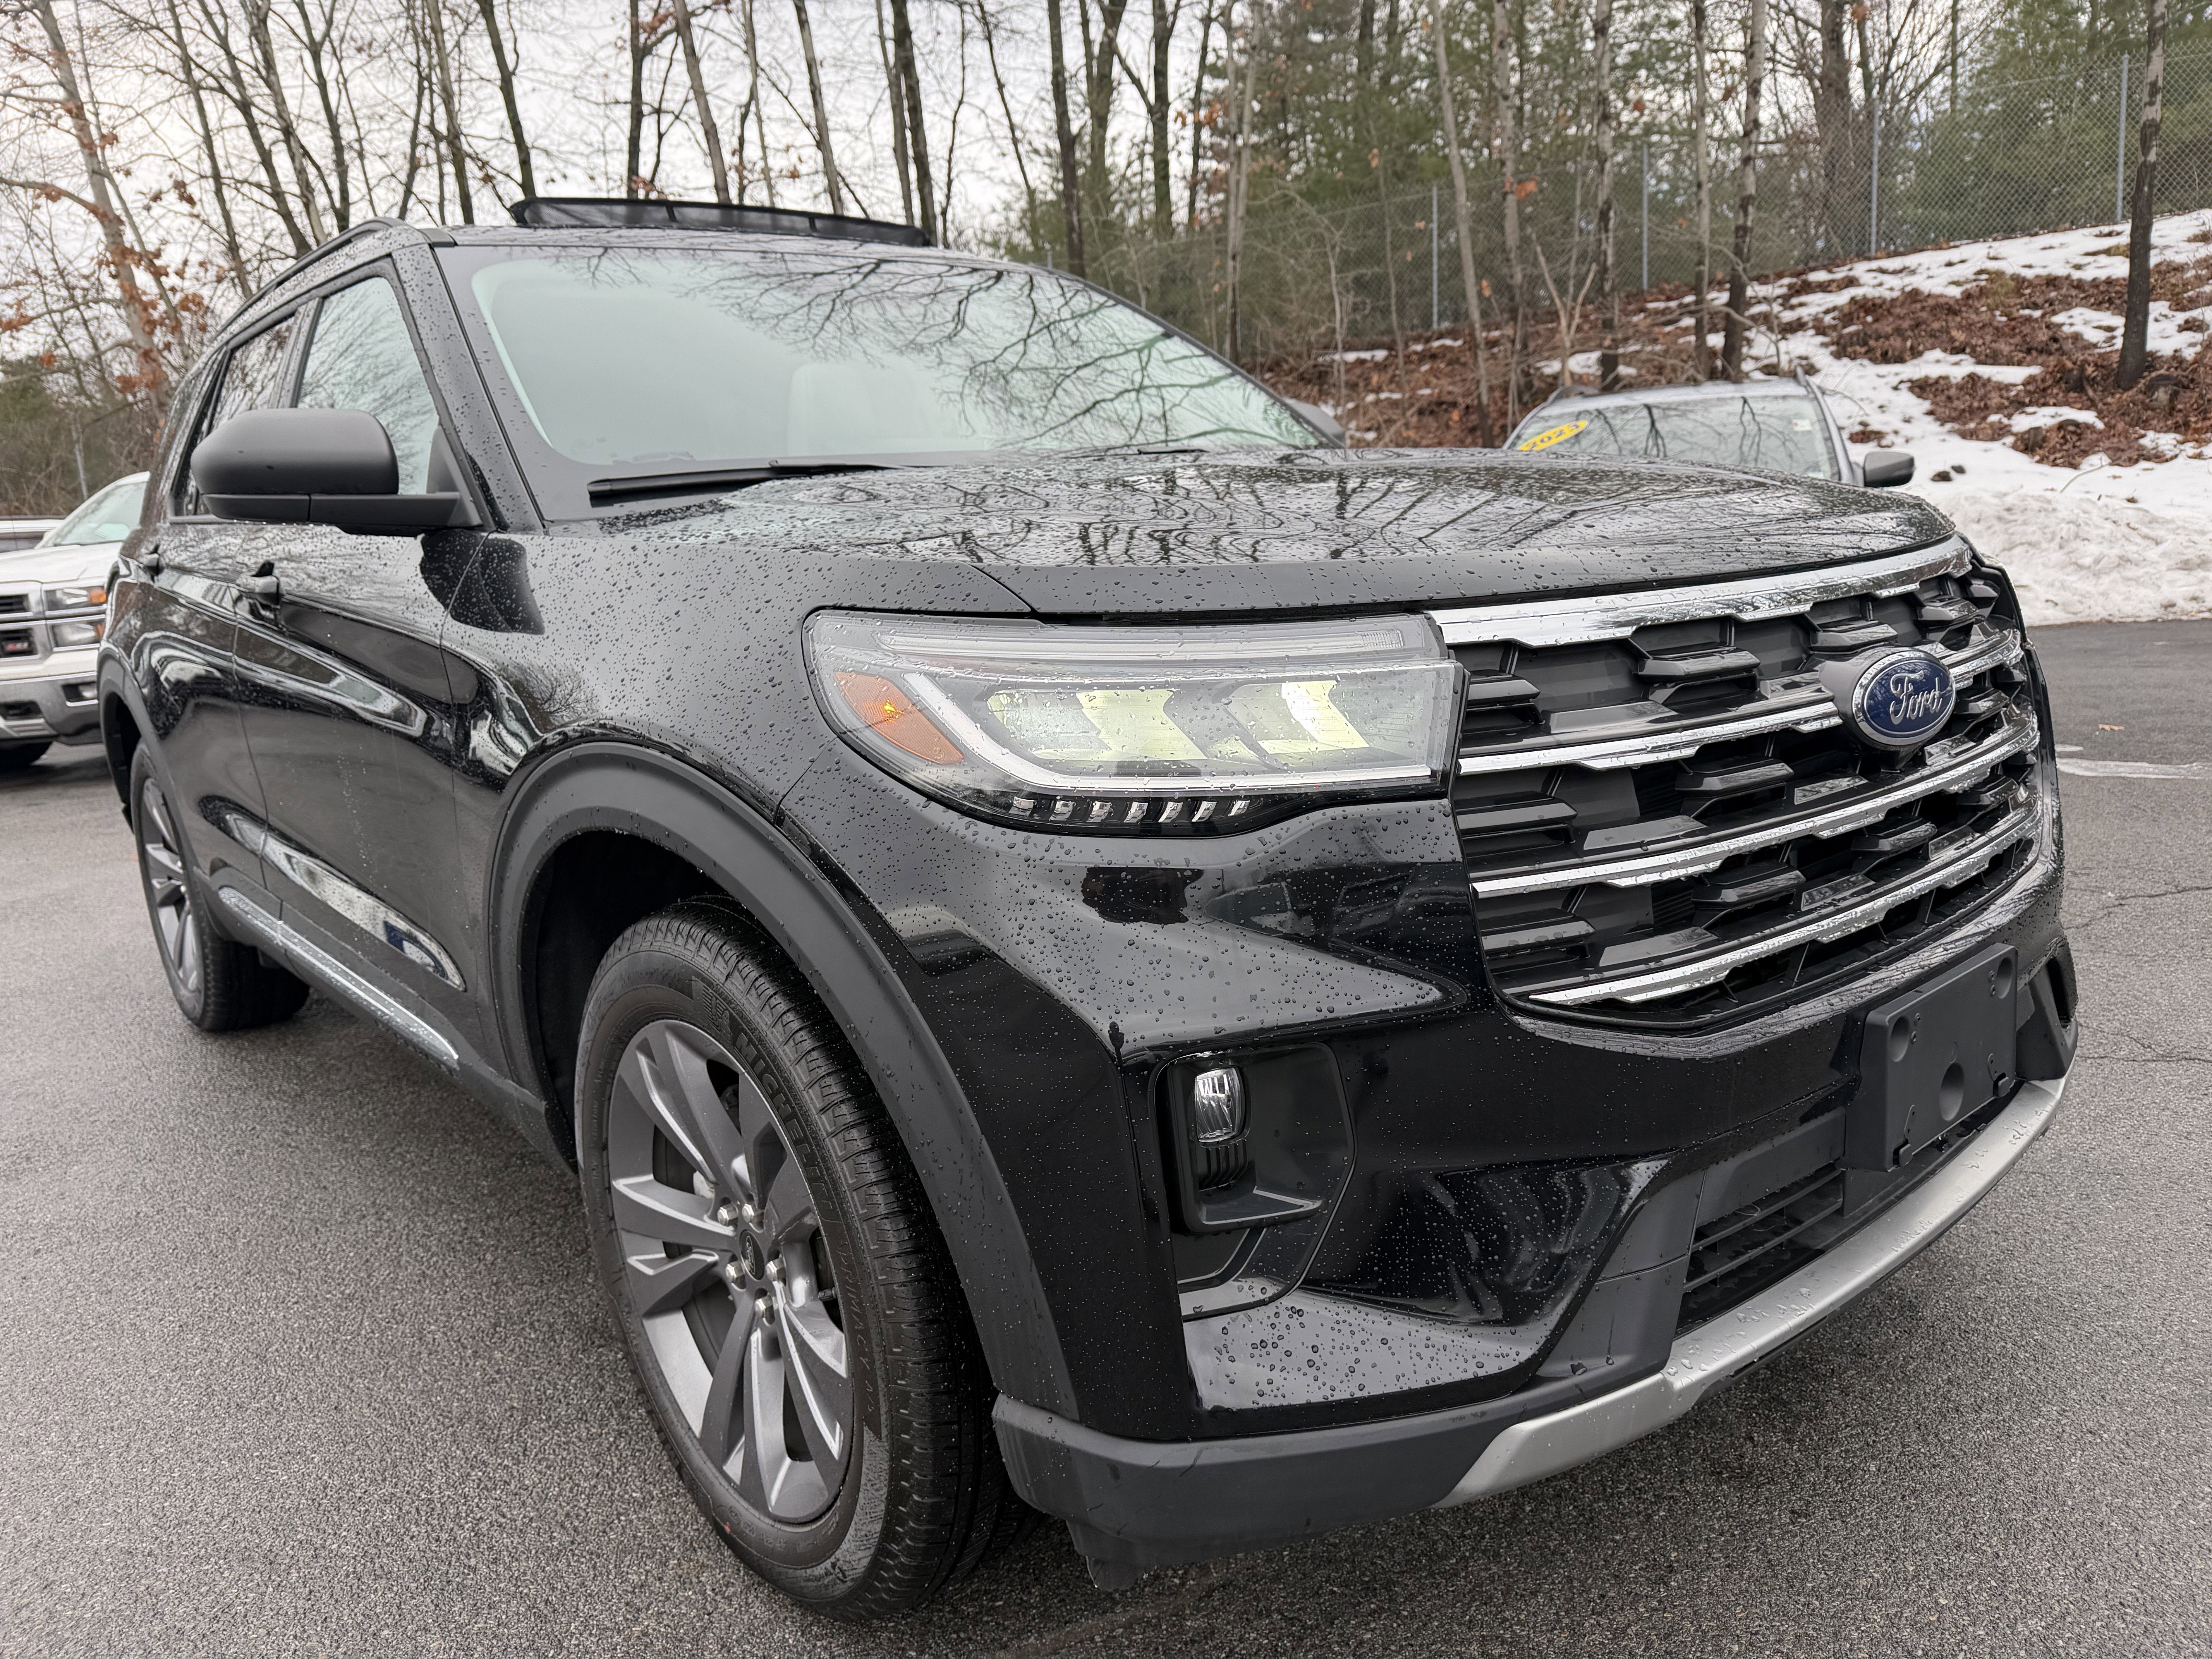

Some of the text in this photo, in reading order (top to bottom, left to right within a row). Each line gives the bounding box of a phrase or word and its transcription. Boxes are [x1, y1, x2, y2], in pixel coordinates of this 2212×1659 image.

[1889, 670, 1943, 725] Ford
[734, 1032, 833, 1210] MICHELIN
[836, 1244, 871, 1371] PRIMACY
